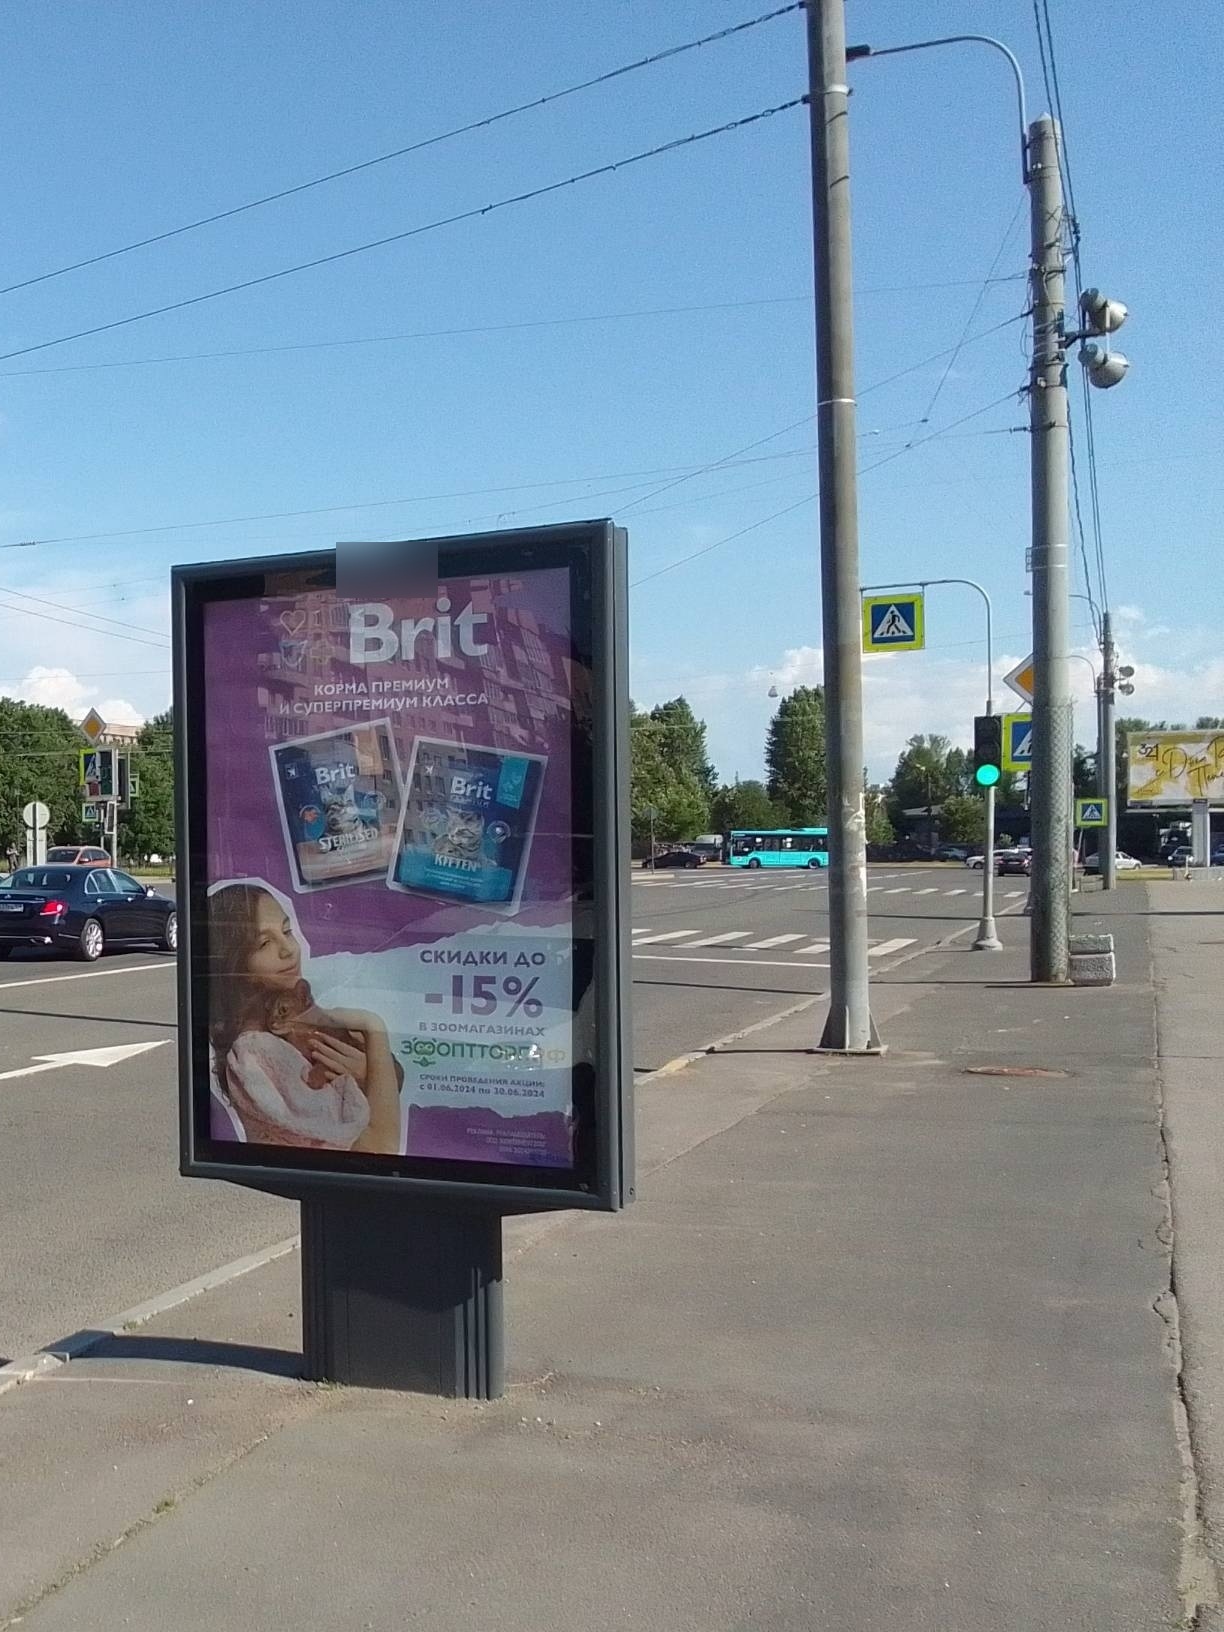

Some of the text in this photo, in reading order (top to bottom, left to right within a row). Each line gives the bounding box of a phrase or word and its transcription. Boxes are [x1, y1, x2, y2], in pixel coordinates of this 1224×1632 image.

[349, 597, 488, 664] Brit
[314, 677, 449, 696] КОРМА ПРЕМИУМ
[279, 692, 489, 717] И СУПЕРПРЕМИУМ КЛАССА
[315, 762, 356, 785] Brit
[450, 775, 493, 800] Brit
[434, 853, 477, 873] KITTEN
[419, 949, 546, 968] СКИДКИ ДО
[424, 974, 544, 1019] -15%
[419, 1022, 545, 1037] В ЗООМАГАЗИНАХ
[419, 1073, 448, 1082] СРОКИ
[450, 1074, 509, 1086] ПРОВЕДЕНИЯ
[427, 1084, 476, 1095] 01.06.2024
